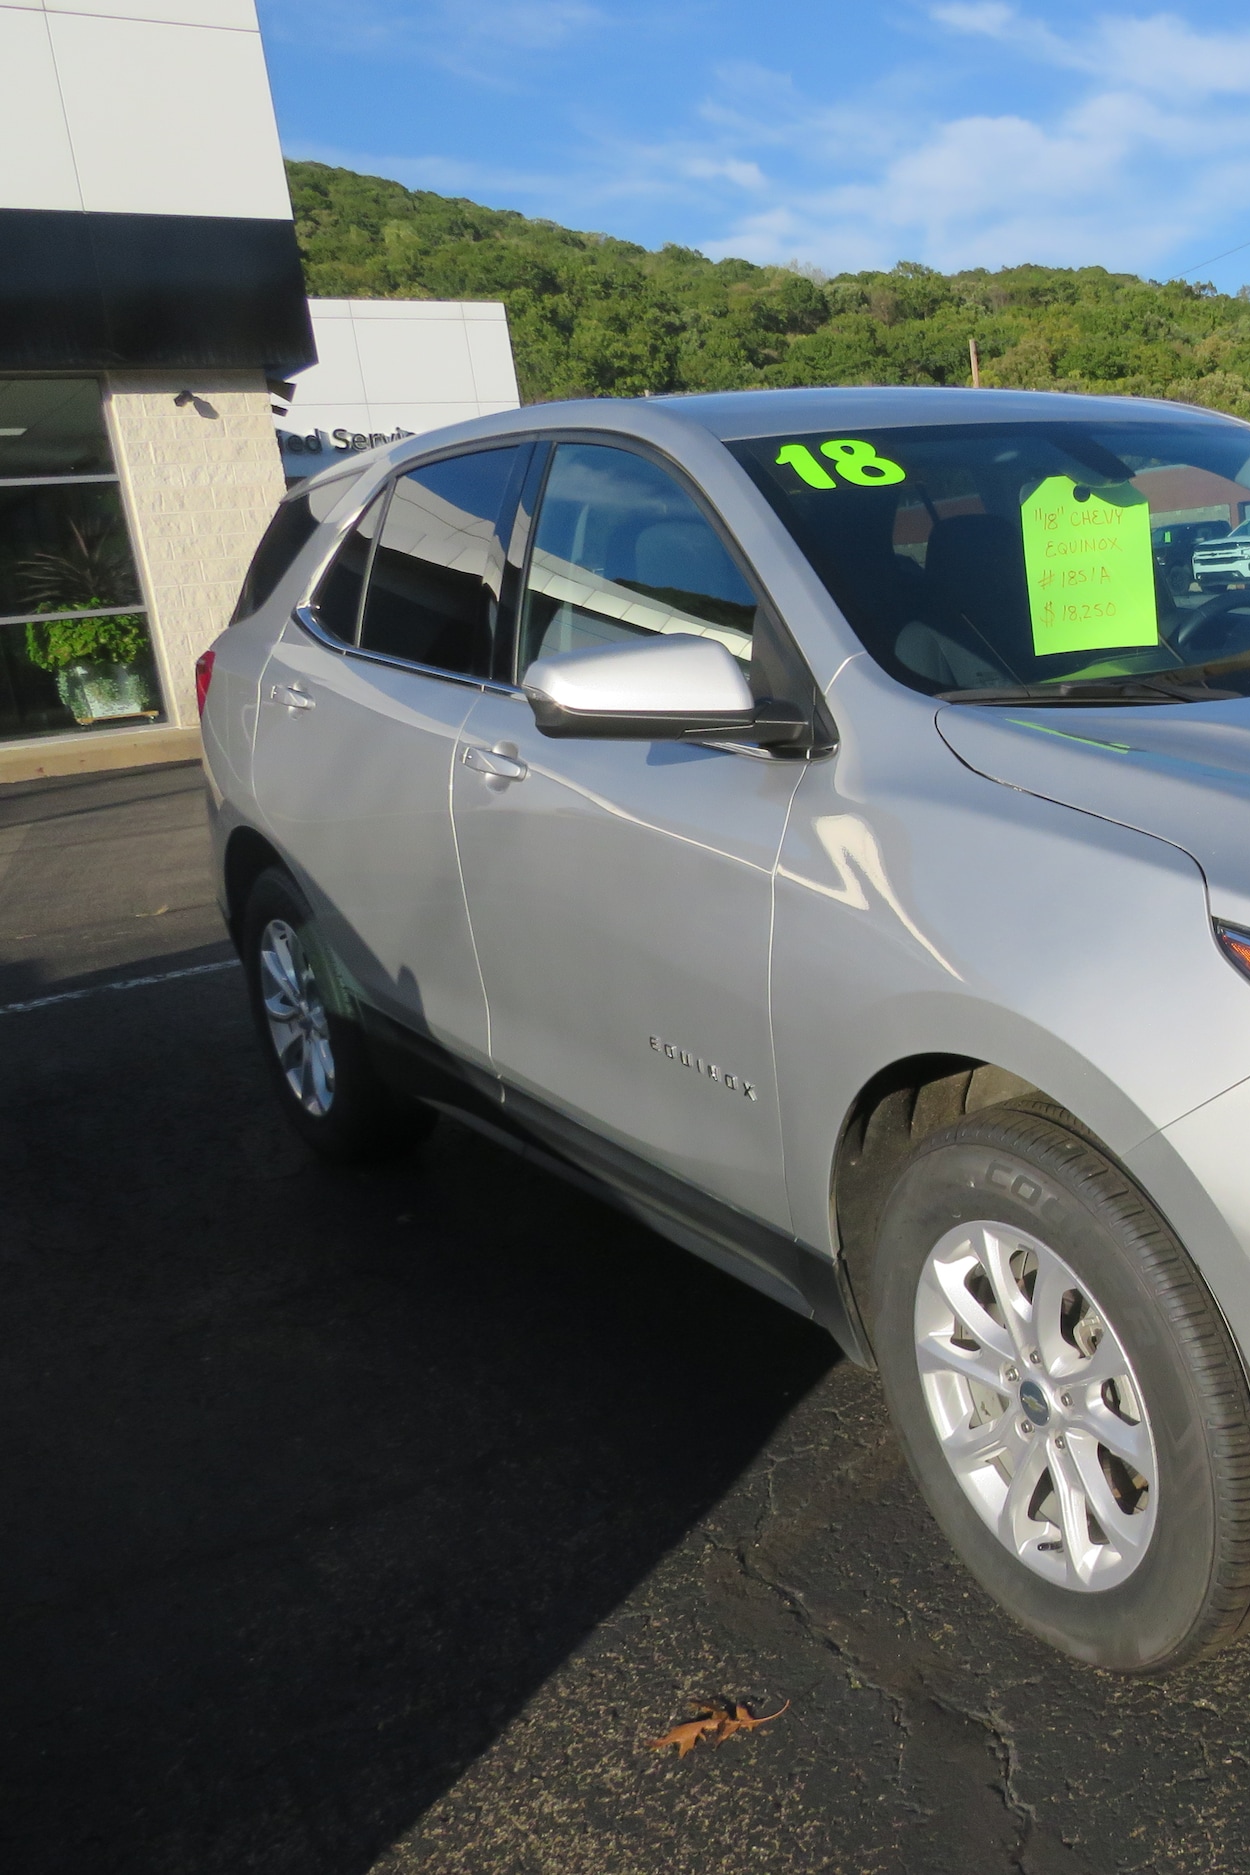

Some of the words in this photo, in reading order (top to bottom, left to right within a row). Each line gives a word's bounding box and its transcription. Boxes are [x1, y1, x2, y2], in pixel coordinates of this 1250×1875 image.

[332, 427, 416, 451] Servi
[775, 439, 907, 490] 18
[1070, 508, 1124, 527] CHEVY
[1045, 537, 1124, 558] EQUINOX
[649, 1034, 758, 1102] EQUINOX
